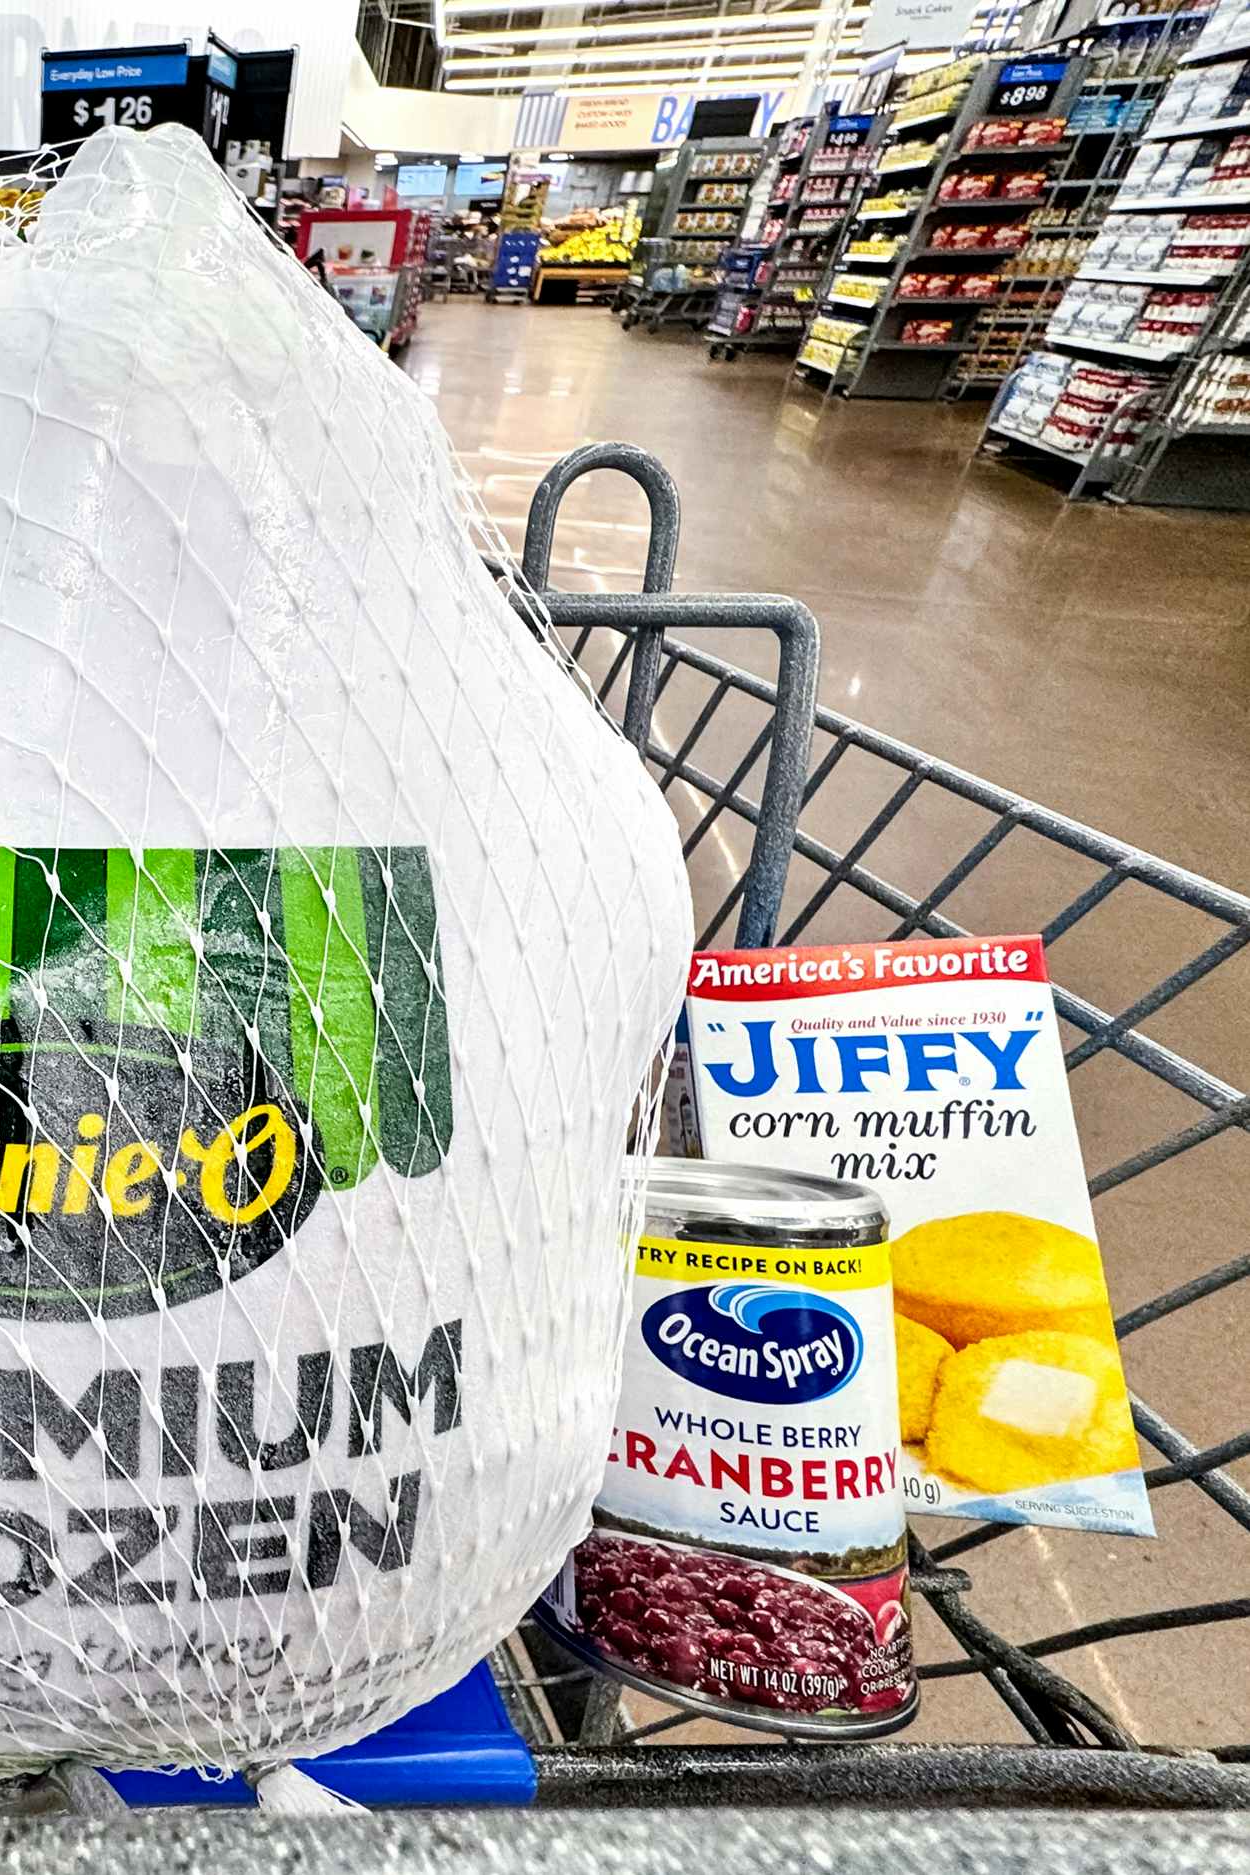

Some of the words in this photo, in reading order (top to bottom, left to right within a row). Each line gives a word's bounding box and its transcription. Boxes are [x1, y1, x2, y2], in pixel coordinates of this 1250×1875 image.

[95, 67, 115, 79] Low
[117, 65, 143, 77] Price
[651, 92, 785, 144] BAY
[692, 951, 865, 989] America's
[874, 945, 1028, 980] Favorite
[790, 1015, 845, 1034] Quality
[847, 1013, 877, 1030] and
[880, 1013, 922, 1030] Value
[926, 1012, 967, 1028] since
[970, 1010, 1008, 1026] 1930
[729, 1110, 840, 1139] corn
[854, 1099, 1036, 1140] muffin
[831, 1142, 937, 1180] mix
[637, 1245, 677, 1265] TRY
[686, 1252, 767, 1274] RECIPE
[775, 1259, 808, 1275] ON
[813, 1258, 862, 1276] BACK!
[658, 1312, 758, 1378] Ocean
[763, 1329, 846, 1389] Spray
[654, 1406, 773, 1446] WHOLE
[784, 1424, 862, 1449] BERRY
[720, 1502, 820, 1533] SAUCE
[1014, 1498, 1062, 1515] SERVING
[1064, 1504, 1135, 1522] SUGGESTION
[76, 1628, 292, 1678] turkey
[870, 1646, 886, 1658] NO
[710, 1657, 736, 1682] NET
[740, 1663, 760, 1687] WT
[763, 1669, 778, 1690] 14
[781, 1672, 798, 1694] OZ
[801, 1675, 840, 1701] (397g)
